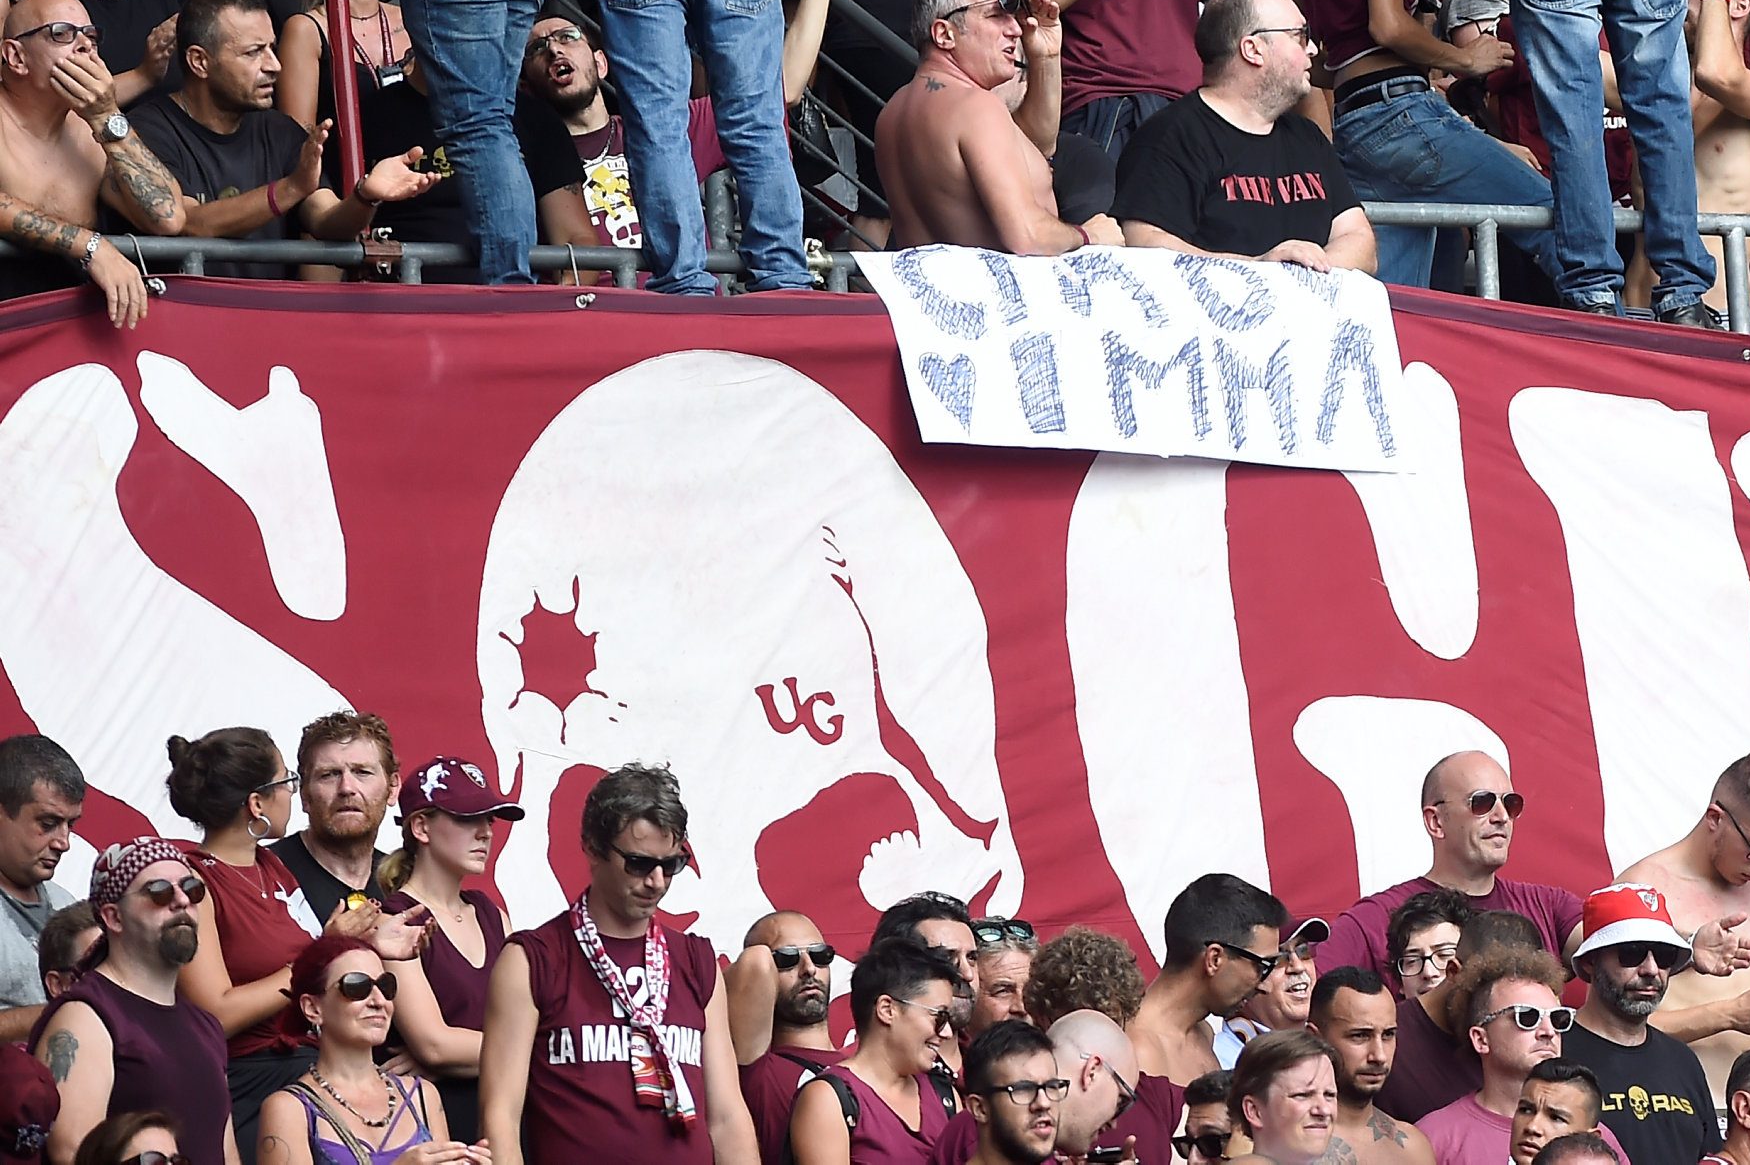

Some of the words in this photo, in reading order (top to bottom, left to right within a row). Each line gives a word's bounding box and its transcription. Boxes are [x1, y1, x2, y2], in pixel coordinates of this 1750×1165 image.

[1220, 173, 1275, 206] THE
[1276, 172, 1327, 204] VAN
[1008, 318, 1397, 460] IMMA
[753, 676, 845, 746] UG
[547, 1026, 577, 1066] LA
